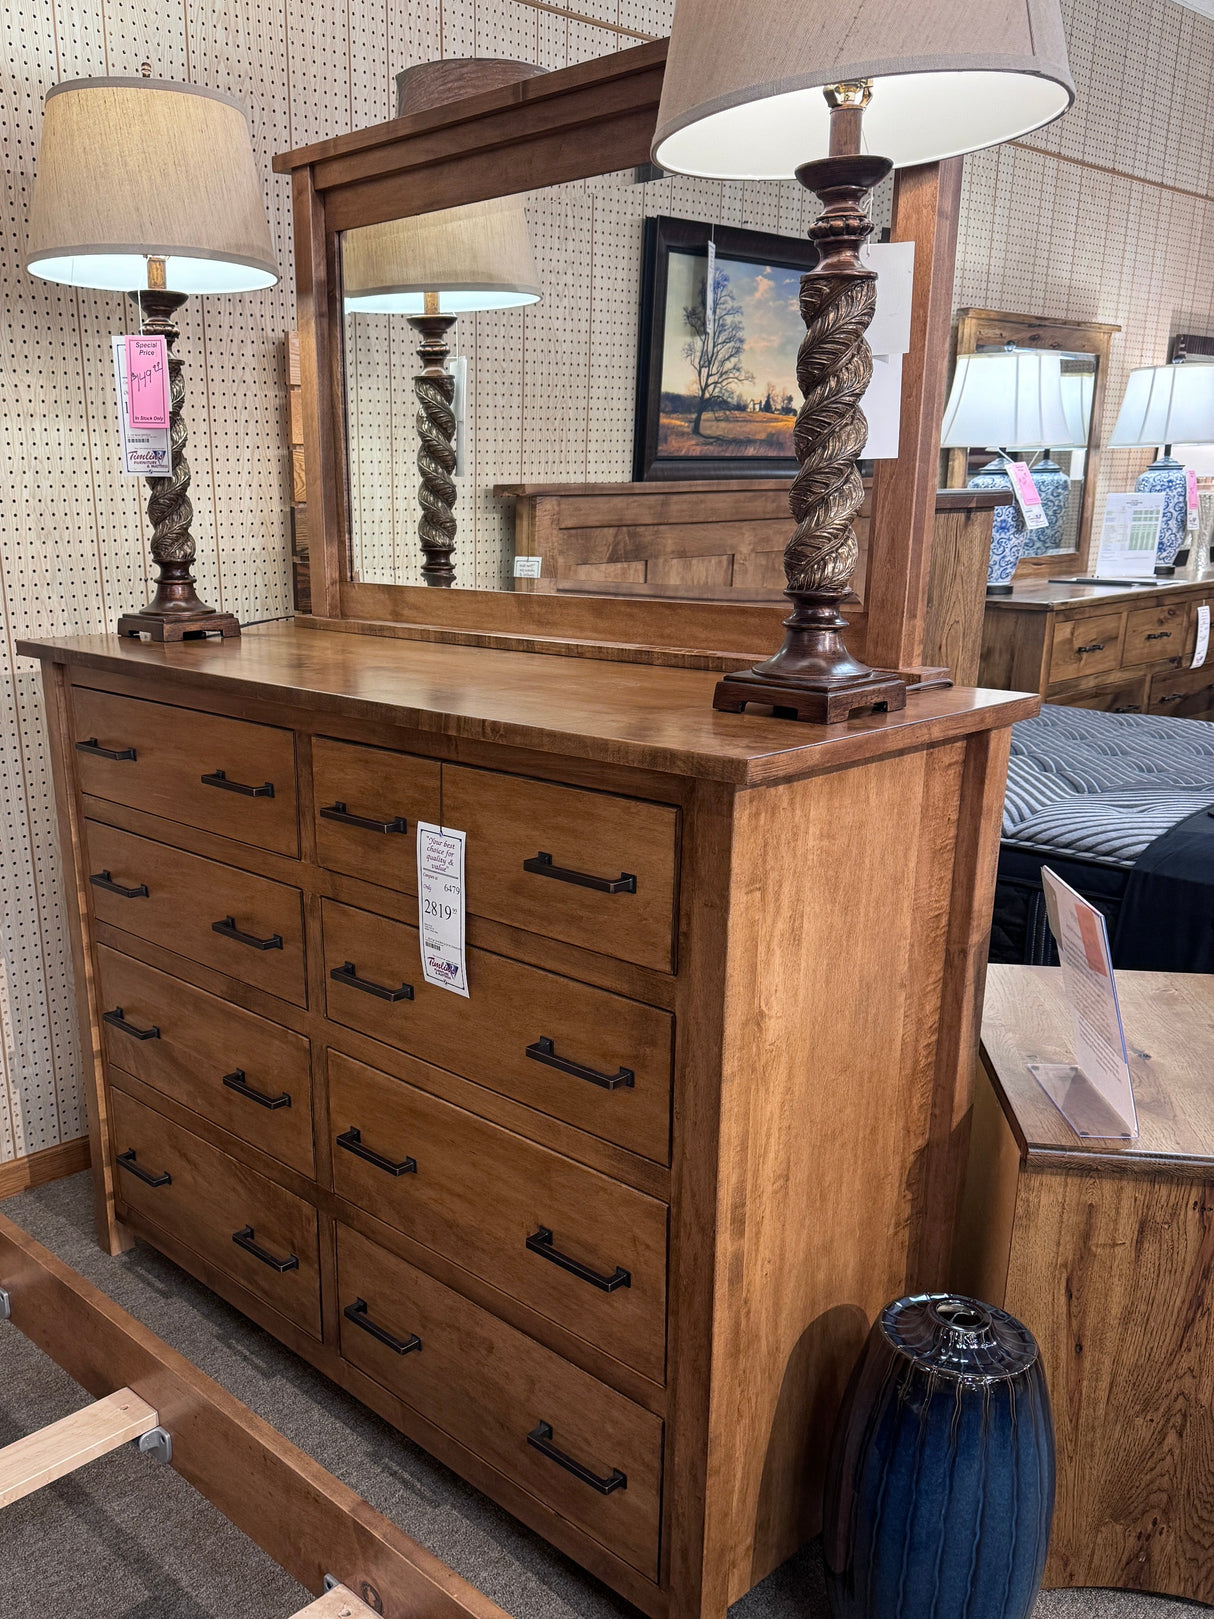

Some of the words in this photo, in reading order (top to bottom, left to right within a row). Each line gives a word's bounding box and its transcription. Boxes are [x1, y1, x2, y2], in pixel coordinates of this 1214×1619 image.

[443, 840, 456, 850] best
[426, 845, 445, 856] choice
[444, 849, 455, 859] for
[426, 854, 447, 867] quality
[447, 859, 455, 867] &
[443, 883, 461, 896] 6479
[424, 898, 452, 921] 2819
